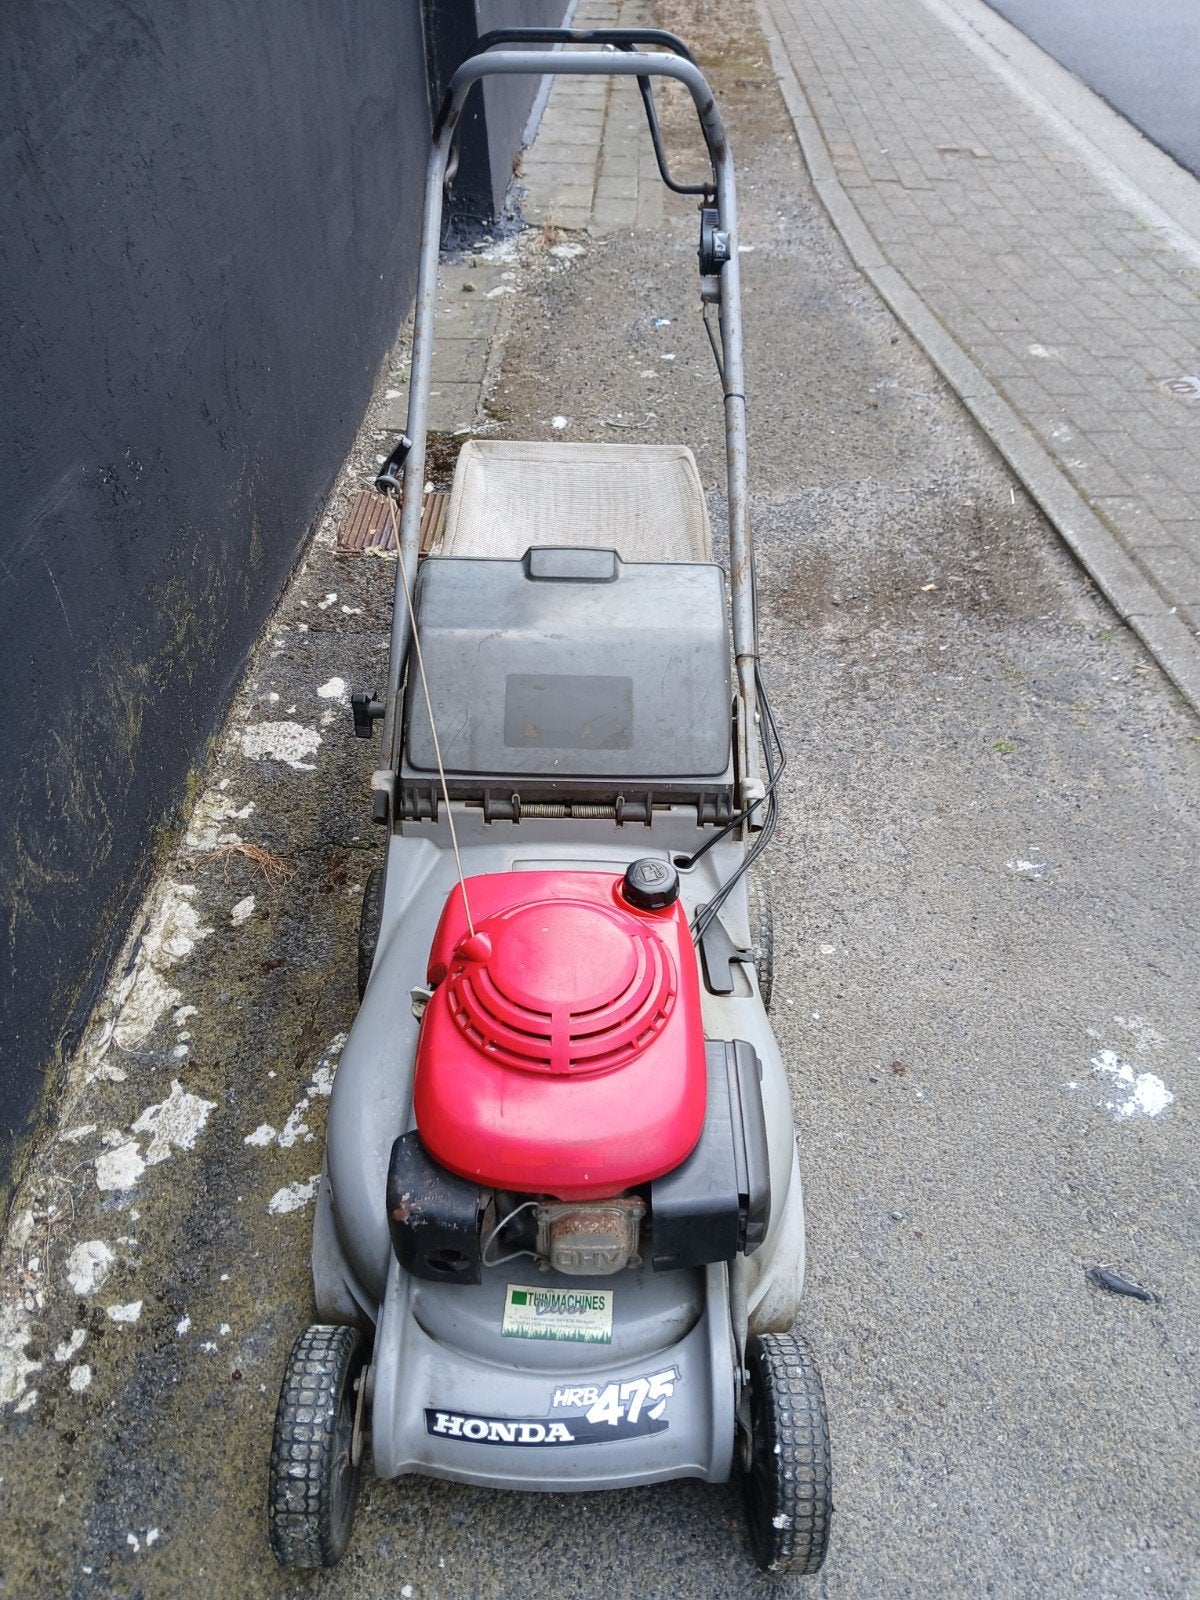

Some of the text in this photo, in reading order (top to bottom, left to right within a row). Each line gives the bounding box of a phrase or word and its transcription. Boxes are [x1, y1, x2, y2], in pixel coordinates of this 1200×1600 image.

[557, 1249, 622, 1266] OHV
[552, 1369, 677, 1426] HRB 475
[433, 1412, 575, 1443] HONDA
